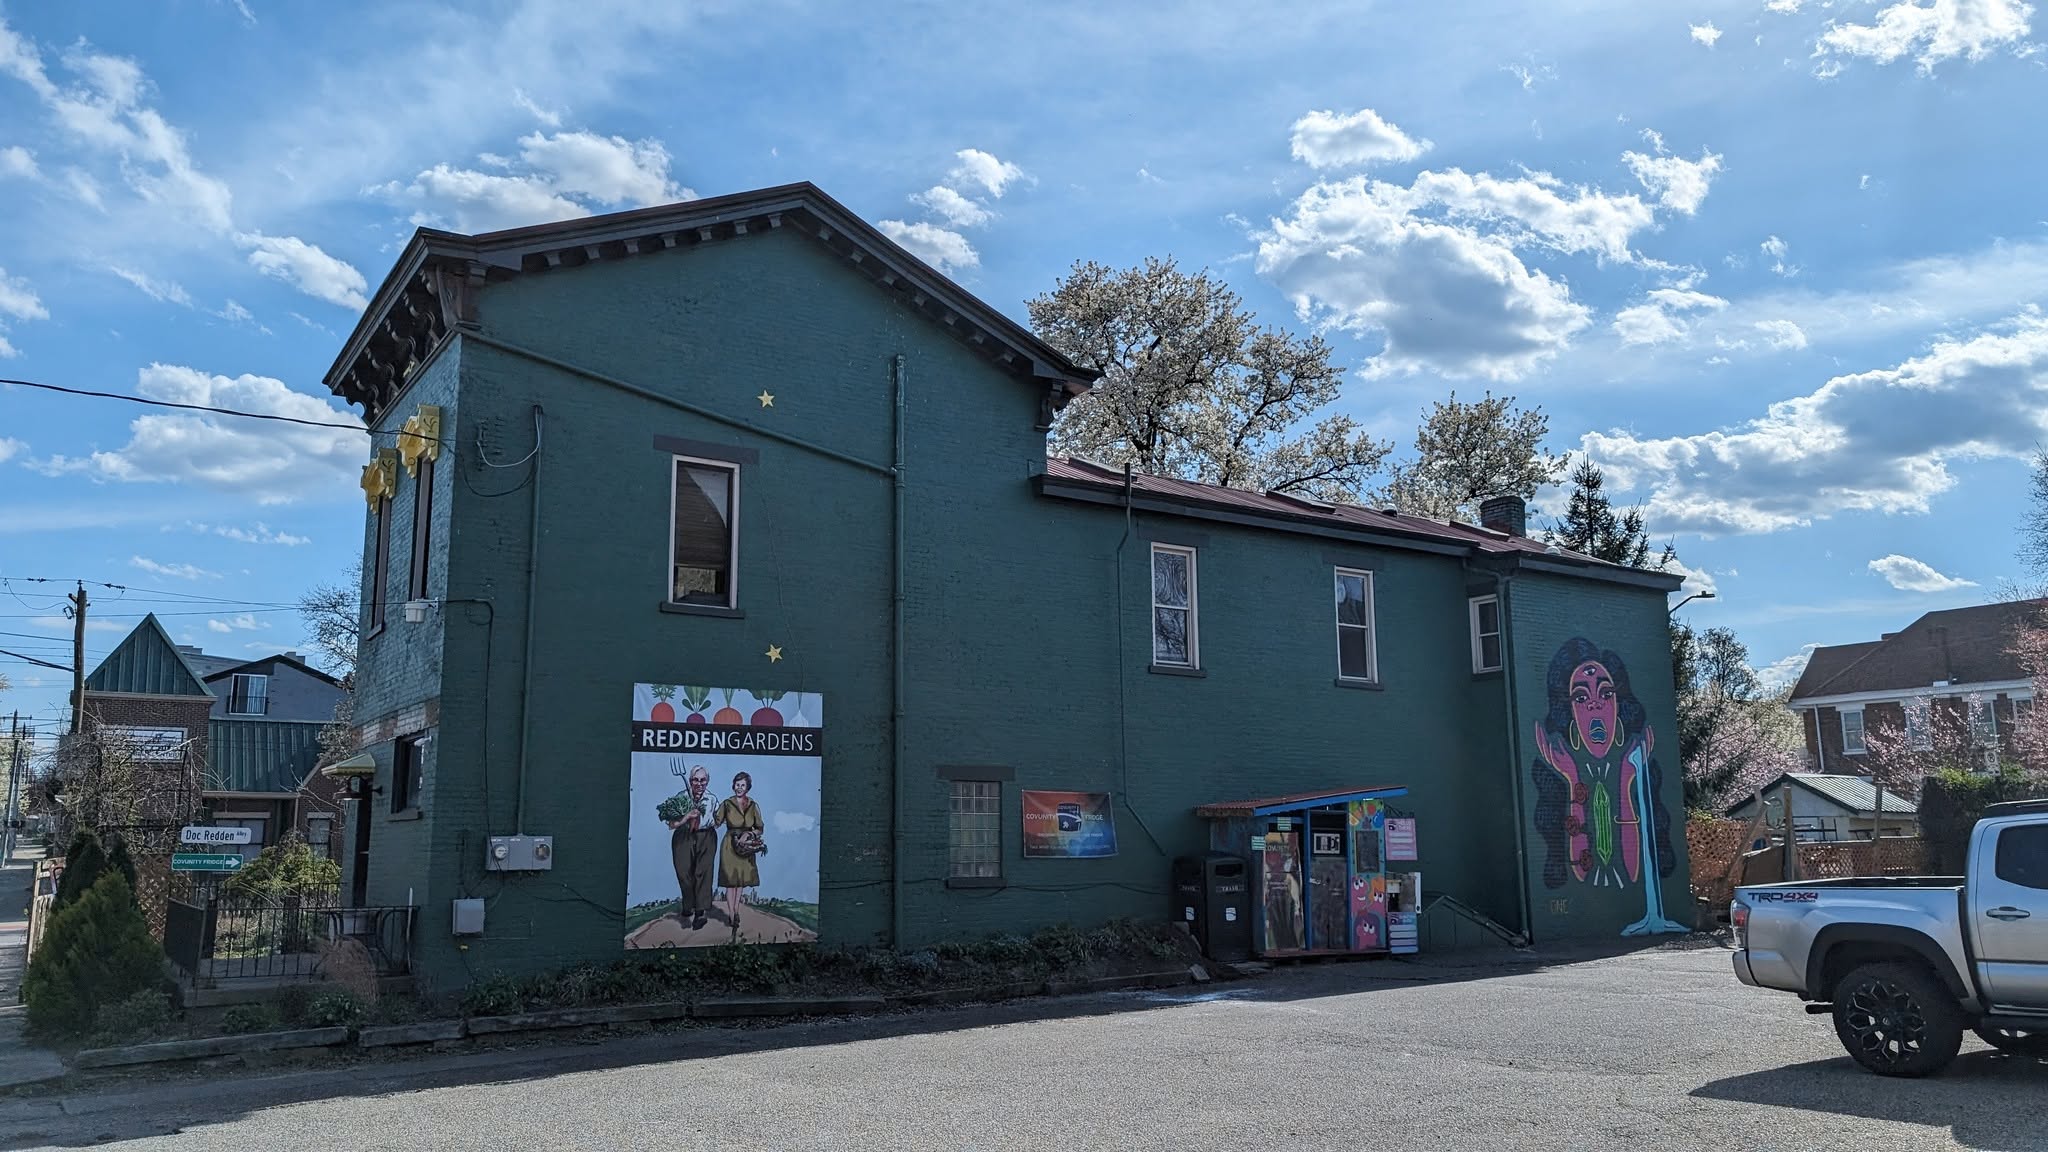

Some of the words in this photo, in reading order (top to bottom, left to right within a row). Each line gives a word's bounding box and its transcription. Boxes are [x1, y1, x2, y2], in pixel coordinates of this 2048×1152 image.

[642, 728, 815, 752] REDDENGARDENS
[1026, 813, 1056, 821] COVUNITY
[185, 829, 202, 841] Doc
[204, 830, 235, 841] Redden
